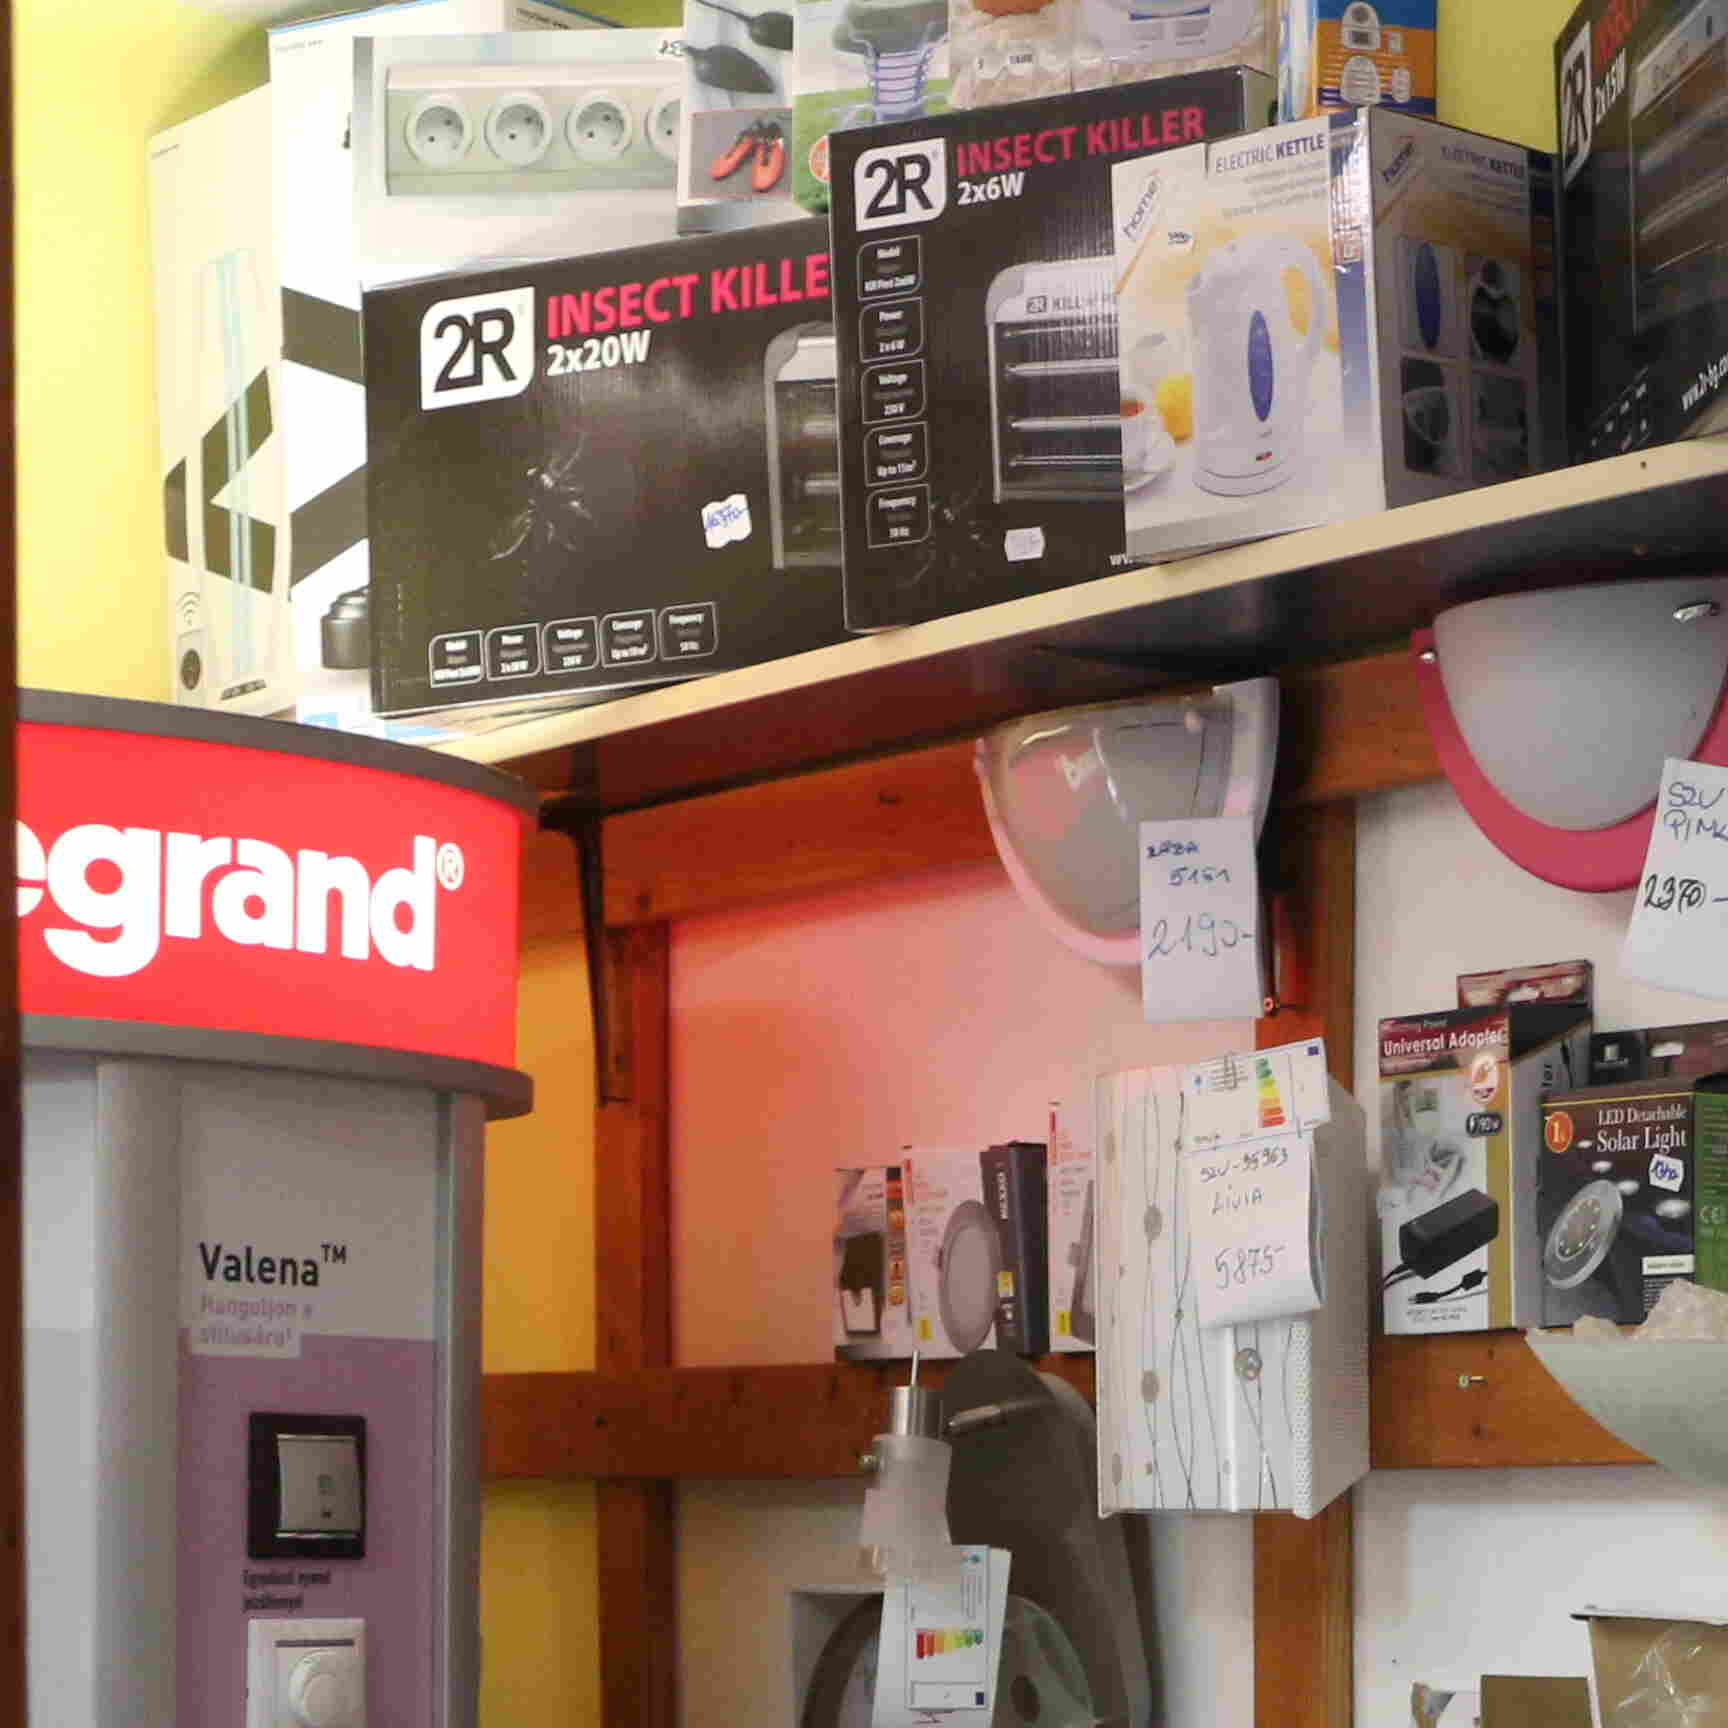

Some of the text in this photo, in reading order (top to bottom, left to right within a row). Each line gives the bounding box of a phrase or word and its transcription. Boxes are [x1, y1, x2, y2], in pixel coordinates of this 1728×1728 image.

[955, 106, 1206, 177] INSECT KILLER
[1216, 134, 1325, 174] ELECTRIC KETTLE
[864, 155, 934, 219] 2R
[957, 172, 1024, 206] 2x6W
[1124, 170, 1161, 238] home
[547, 254, 831, 338] INSECT KILLE
[434, 308, 517, 393] 2R
[546, 330, 651, 376] 2x20W
[1383, 1036, 1445, 1057] Universal
[1598, 1103, 1688, 1124] LED Detachable
[1597, 1125, 1687, 1154] Solar Light
